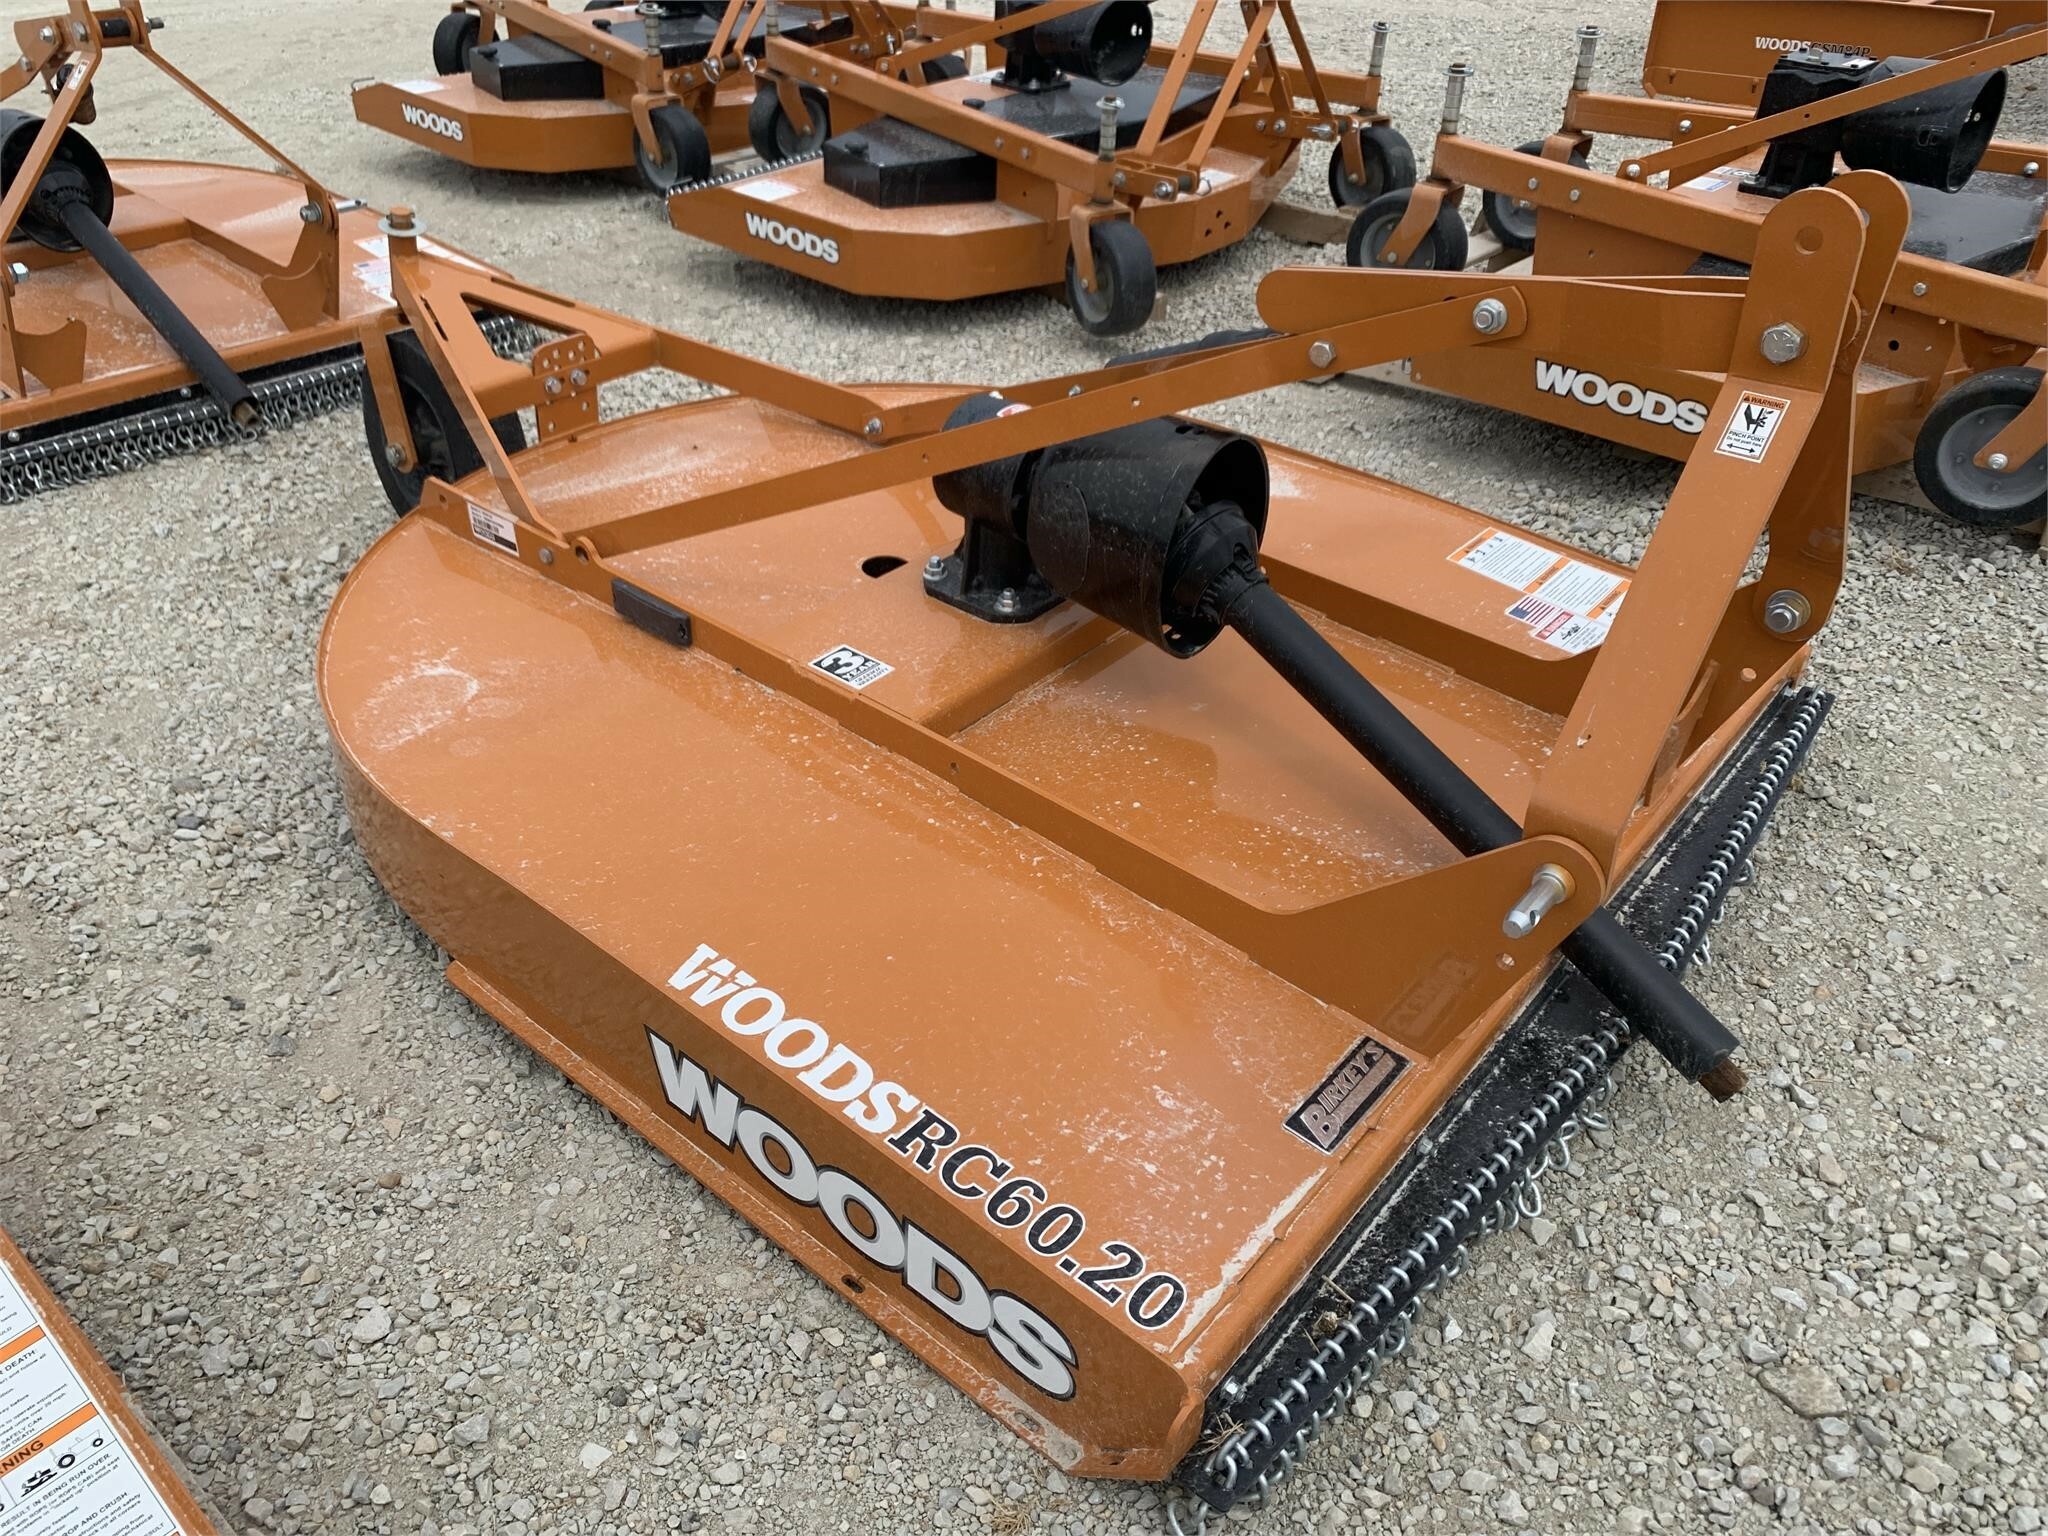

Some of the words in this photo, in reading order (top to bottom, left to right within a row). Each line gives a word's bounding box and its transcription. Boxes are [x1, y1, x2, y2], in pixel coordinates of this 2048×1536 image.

[1755, 36, 1811, 52] WOODS
[401, 102, 464, 142] WOODS
[745, 210, 840, 264] WOODS
[1535, 358, 1710, 434] WOODS
[1751, 396, 1785, 409] WARNING
[1728, 431, 1747, 439] PINCH
[1747, 434, 1765, 442] POINT
[821, 650, 865, 674] 3
[667, 942, 920, 1135] WOODS
[887, 1105, 1188, 1332] RC60.20
[645, 1024, 1079, 1400] WOODS
[1, 1426, 26, 1445] SAFELY
[28, 1416, 42, 1428] CAN
[0, 1440, 44, 1475] NING
[1, 1505, 30, 1528] RESULT
[33, 1499, 41, 1507] IN
[42, 1482, 68, 1501] BEING
[69, 1468, 87, 1483] RUN
[58, 1485, 77, 1499] ROPS
[79, 1515, 109, 1536] structions
[110, 1505, 121, 1516] and
[81, 1512, 98, 1526] AND
